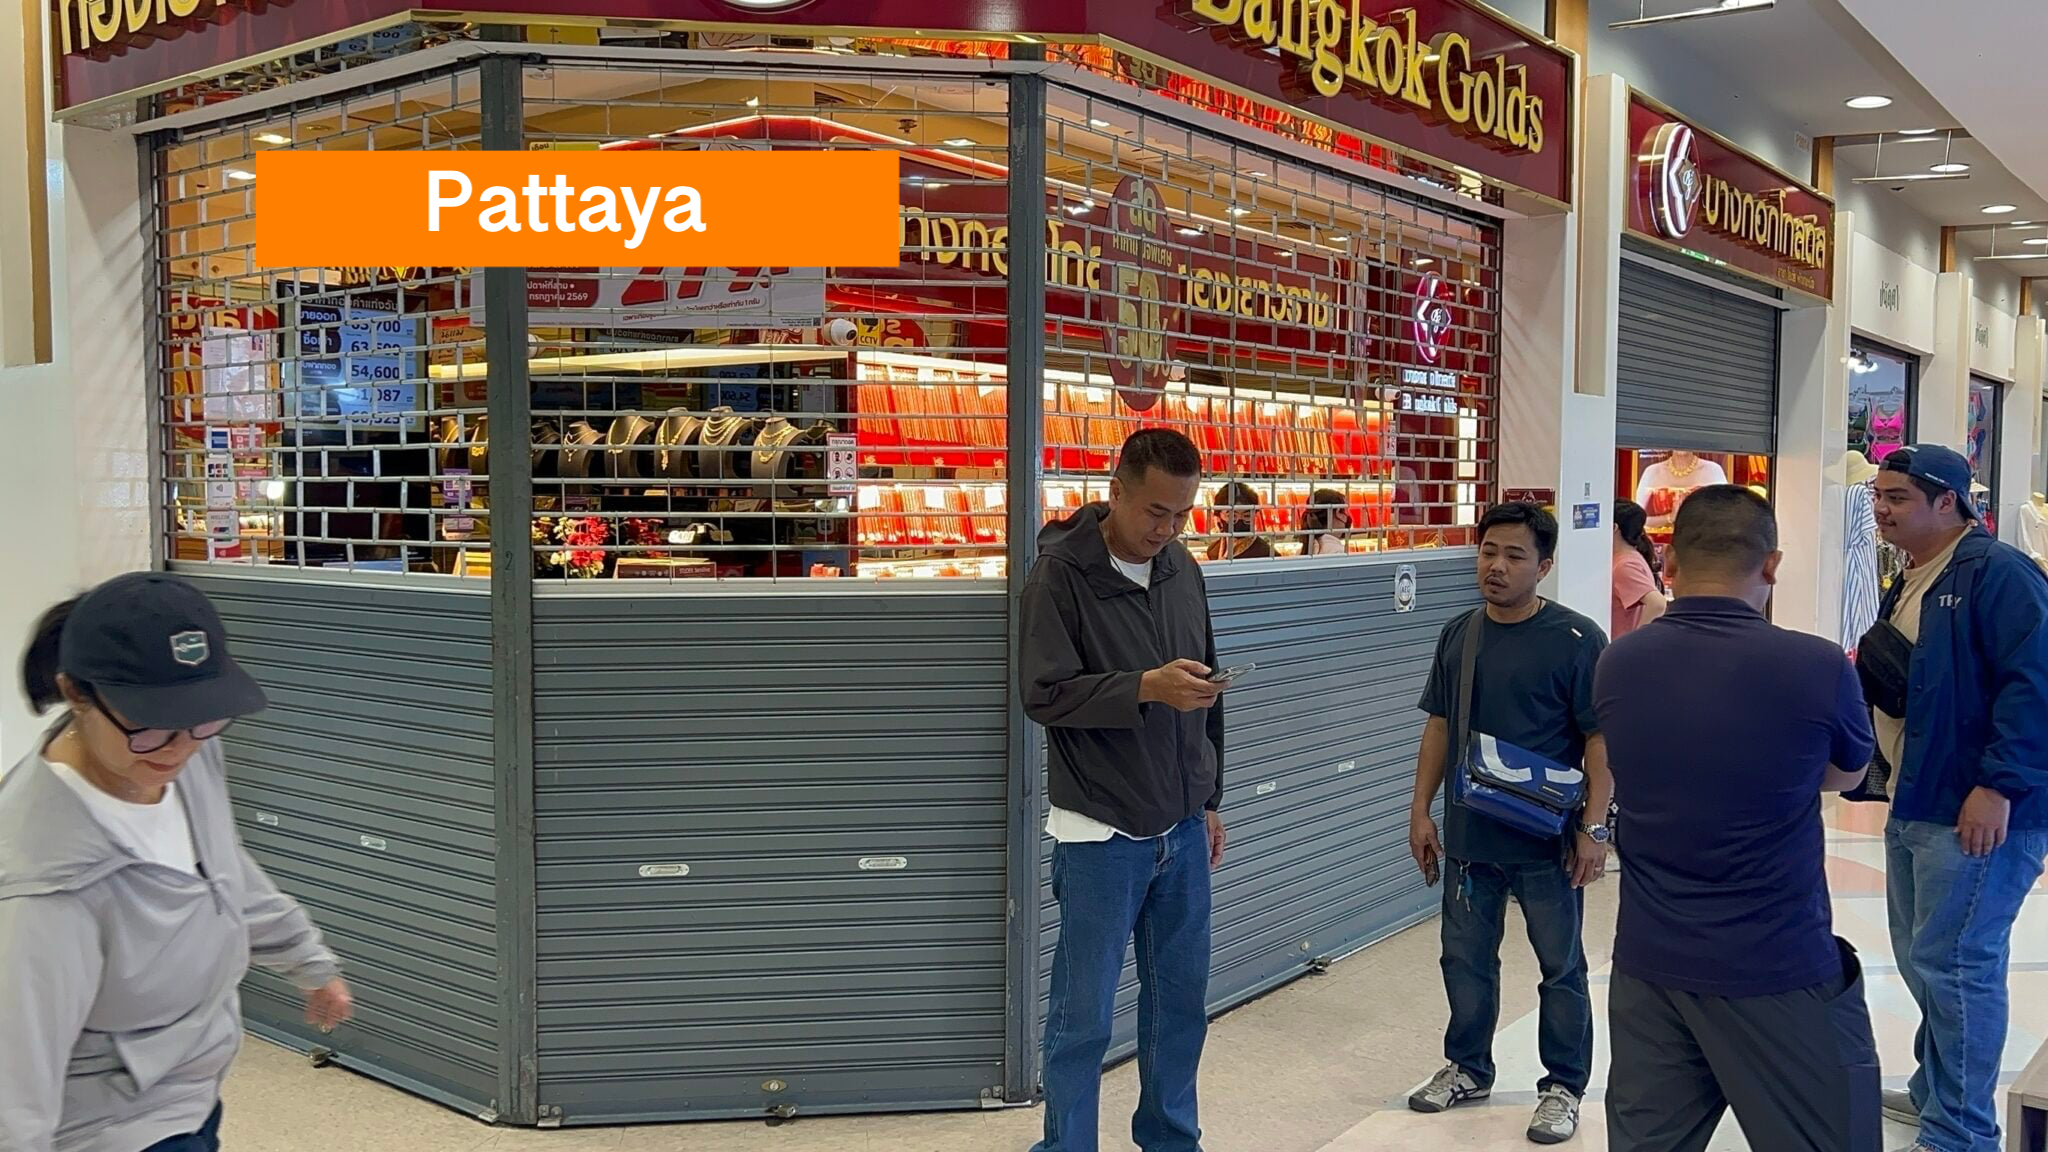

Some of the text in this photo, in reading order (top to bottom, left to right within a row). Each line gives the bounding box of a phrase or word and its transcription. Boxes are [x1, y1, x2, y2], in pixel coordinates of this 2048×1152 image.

[1192, 0, 1545, 153] angkok Golds
[567, 292, 589, 301] 2569
[860, 335, 878, 345] CCTV
[351, 364, 400, 380] 54,600
